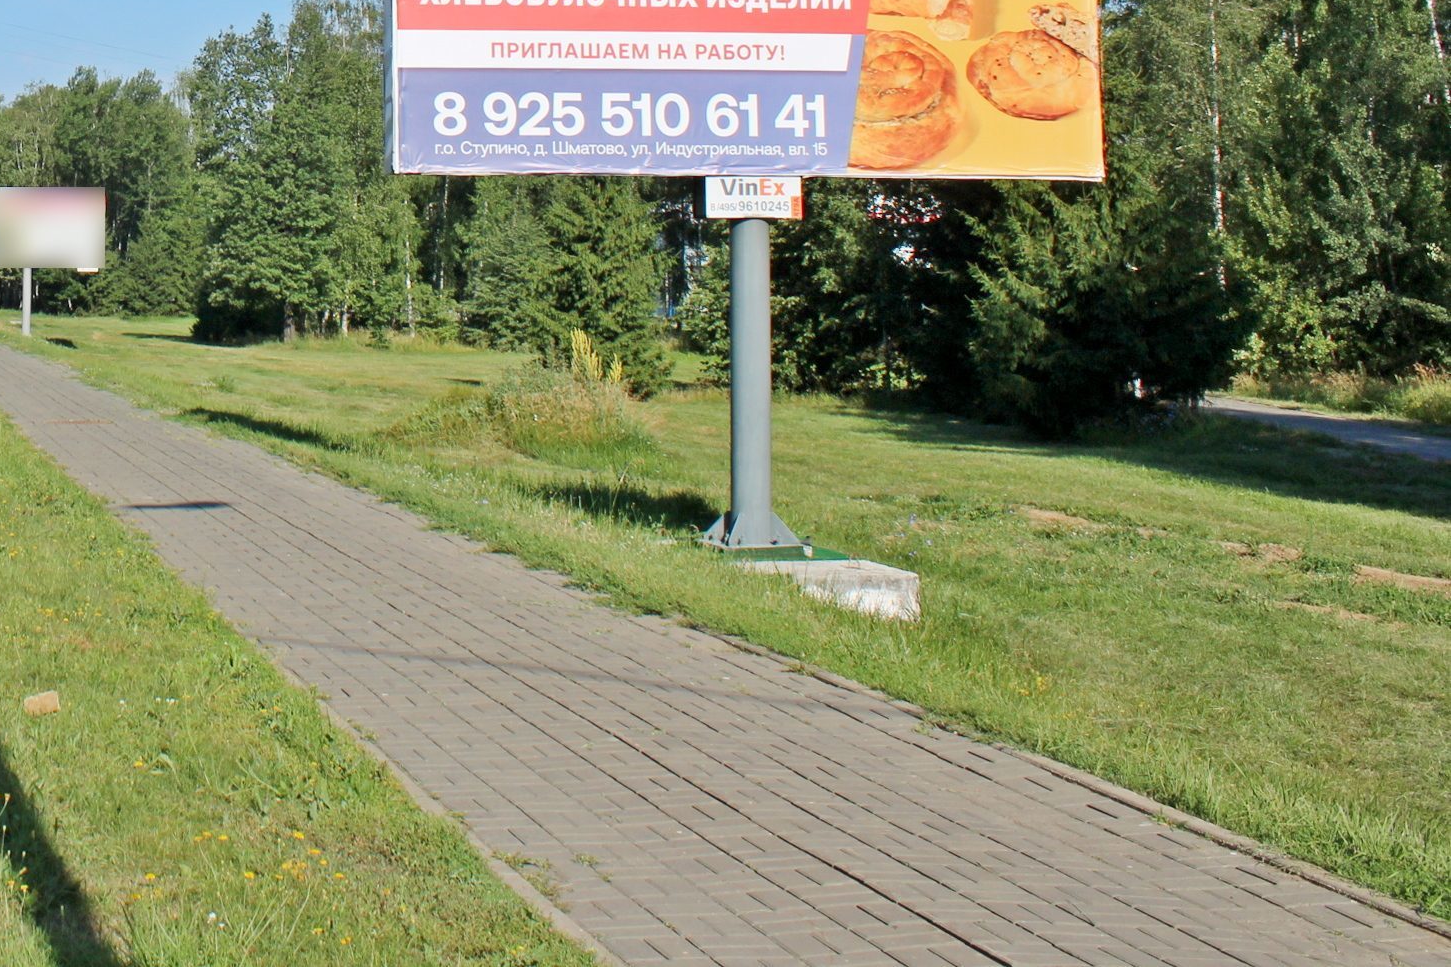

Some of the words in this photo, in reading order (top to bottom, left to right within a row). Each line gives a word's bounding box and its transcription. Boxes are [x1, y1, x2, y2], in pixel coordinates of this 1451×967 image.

[491, 42, 649, 59] ПРИГЛАШАЕМ
[657, 43, 688, 60] НА
[695, 43, 786, 62] РАБОТУ!
[433, 92, 467, 136] 8
[482, 92, 586, 138] 925
[600, 92, 691, 138] 510
[705, 93, 761, 138] 61
[774, 93, 826, 138] 41
[434, 143, 457, 156] г.о.
[459, 140, 532, 158] Ступино,
[534, 142, 548, 156] д.
[552, 141, 627, 159] Шматово,
[630, 144, 652, 159] ул.
[655, 142, 785, 159] Индустриальная,
[788, 145, 809, 157] вл.
[812, 143, 827, 156] 15
[720, 178, 786, 196] VinEx
